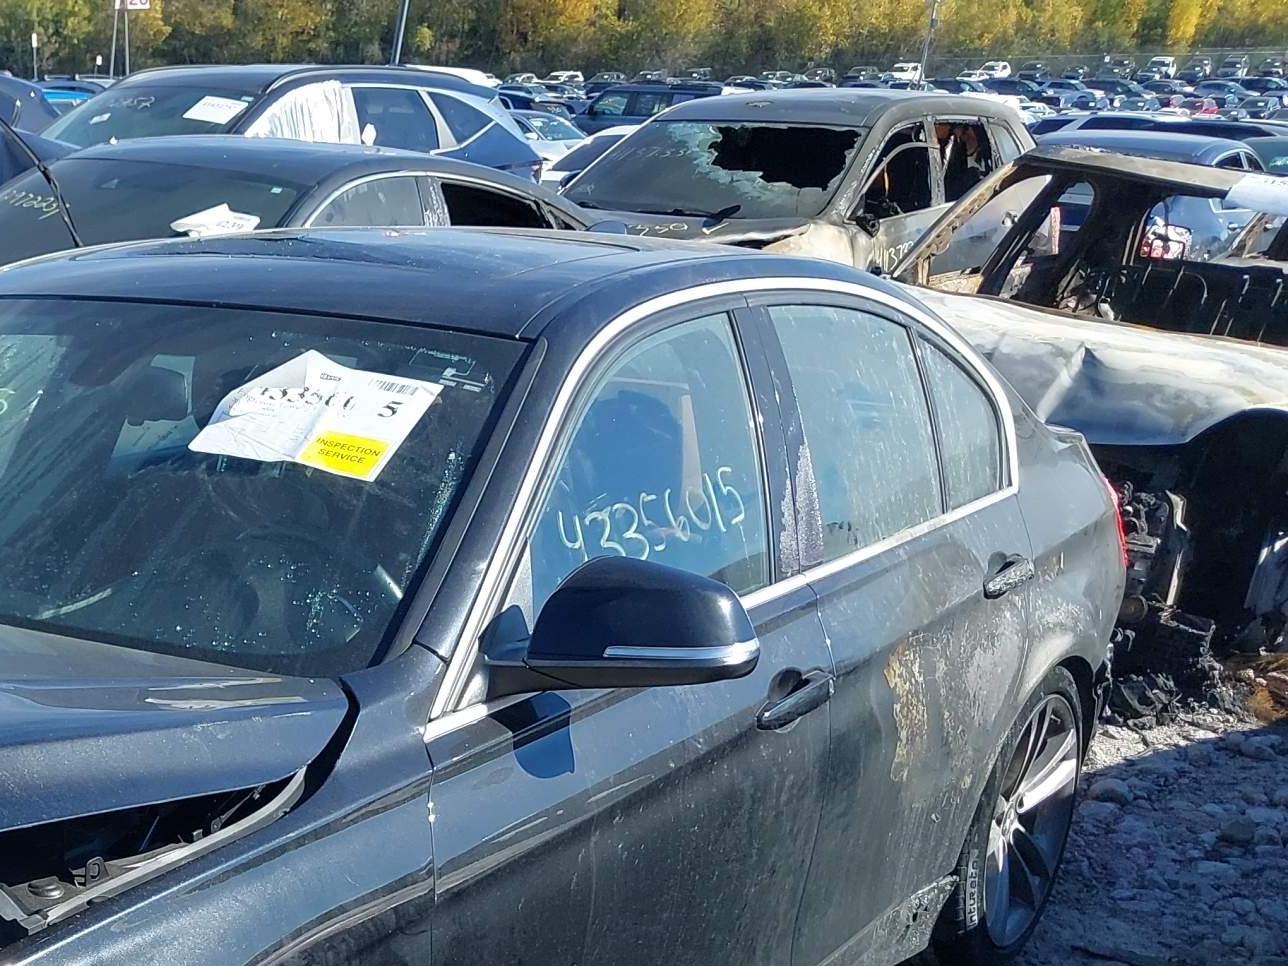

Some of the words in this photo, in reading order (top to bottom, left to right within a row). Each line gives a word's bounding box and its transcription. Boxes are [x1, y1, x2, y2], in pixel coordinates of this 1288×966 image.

[316, 437, 381, 457] INSPECTION
[318, 448, 367, 464] SERVICE
[558, 466, 746, 562] 43356015
